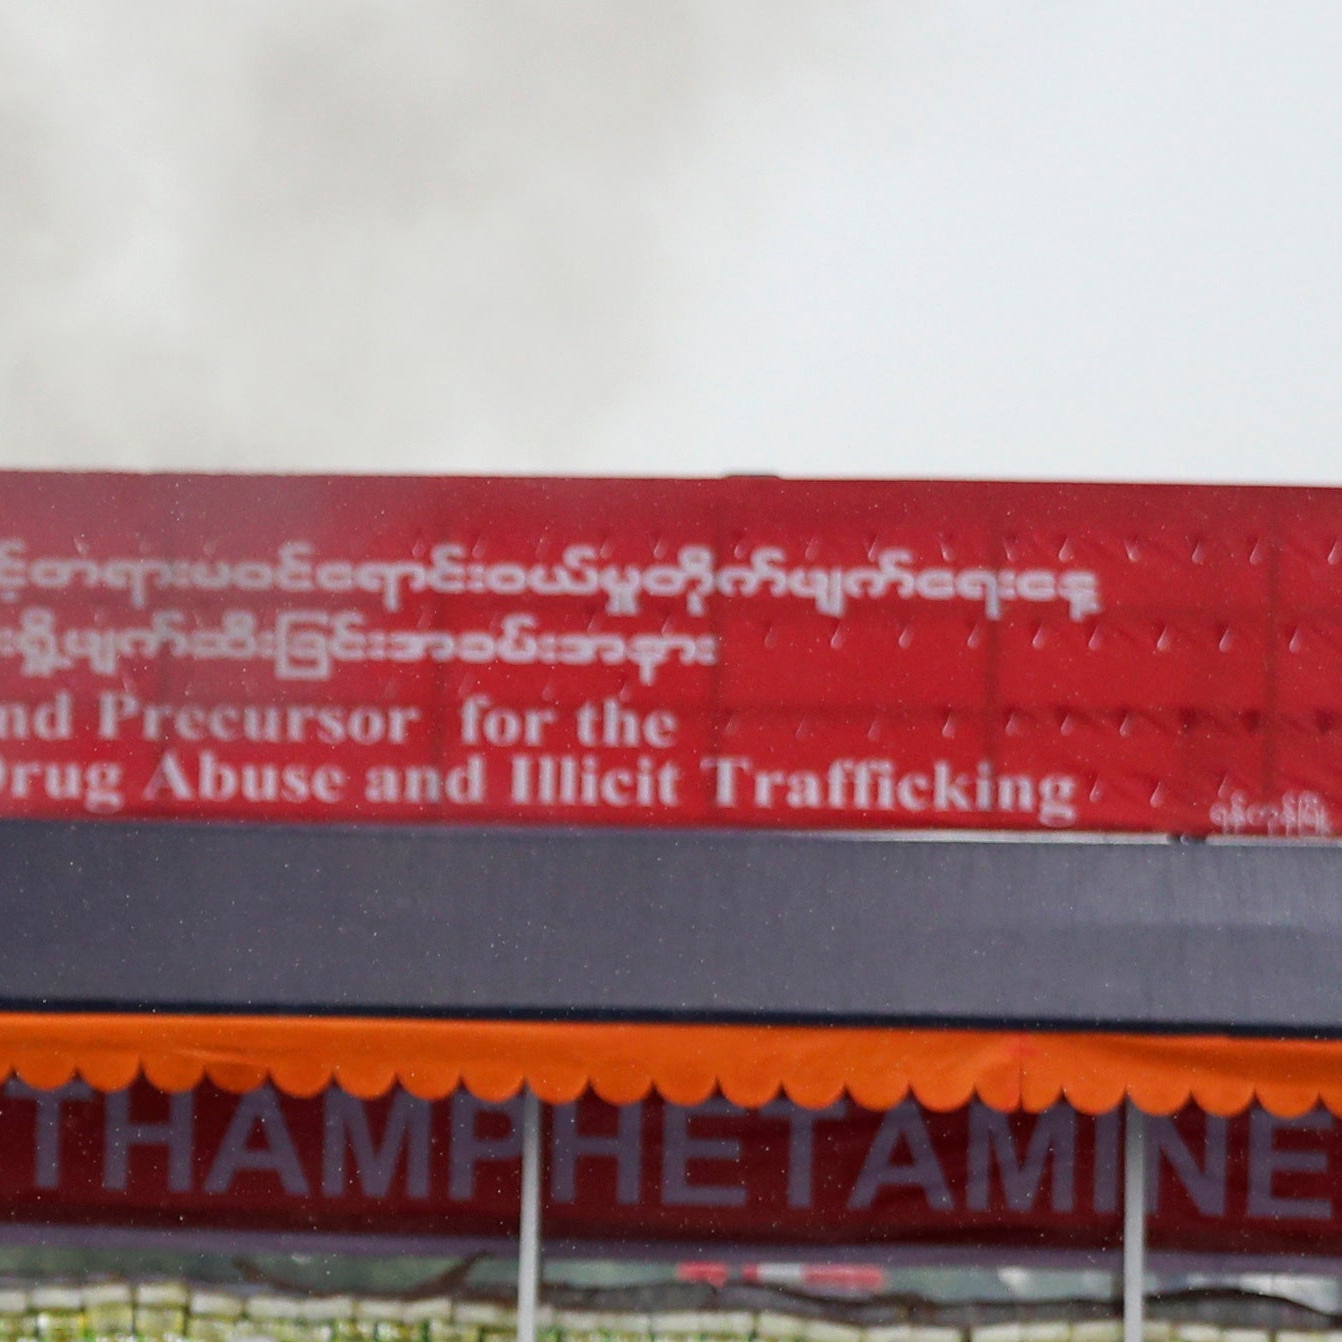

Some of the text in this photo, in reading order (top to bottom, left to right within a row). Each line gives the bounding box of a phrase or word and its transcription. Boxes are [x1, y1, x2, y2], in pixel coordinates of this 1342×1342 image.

[98, 692, 419, 745] Precursor
[461, 695, 562, 747] for
[577, 696, 678, 748] the
[144, 752, 344, 804] Abuse
[366, 754, 485, 806] and
[512, 756, 680, 808] Illicit
[701, 757, 1078, 825] Trafficking
